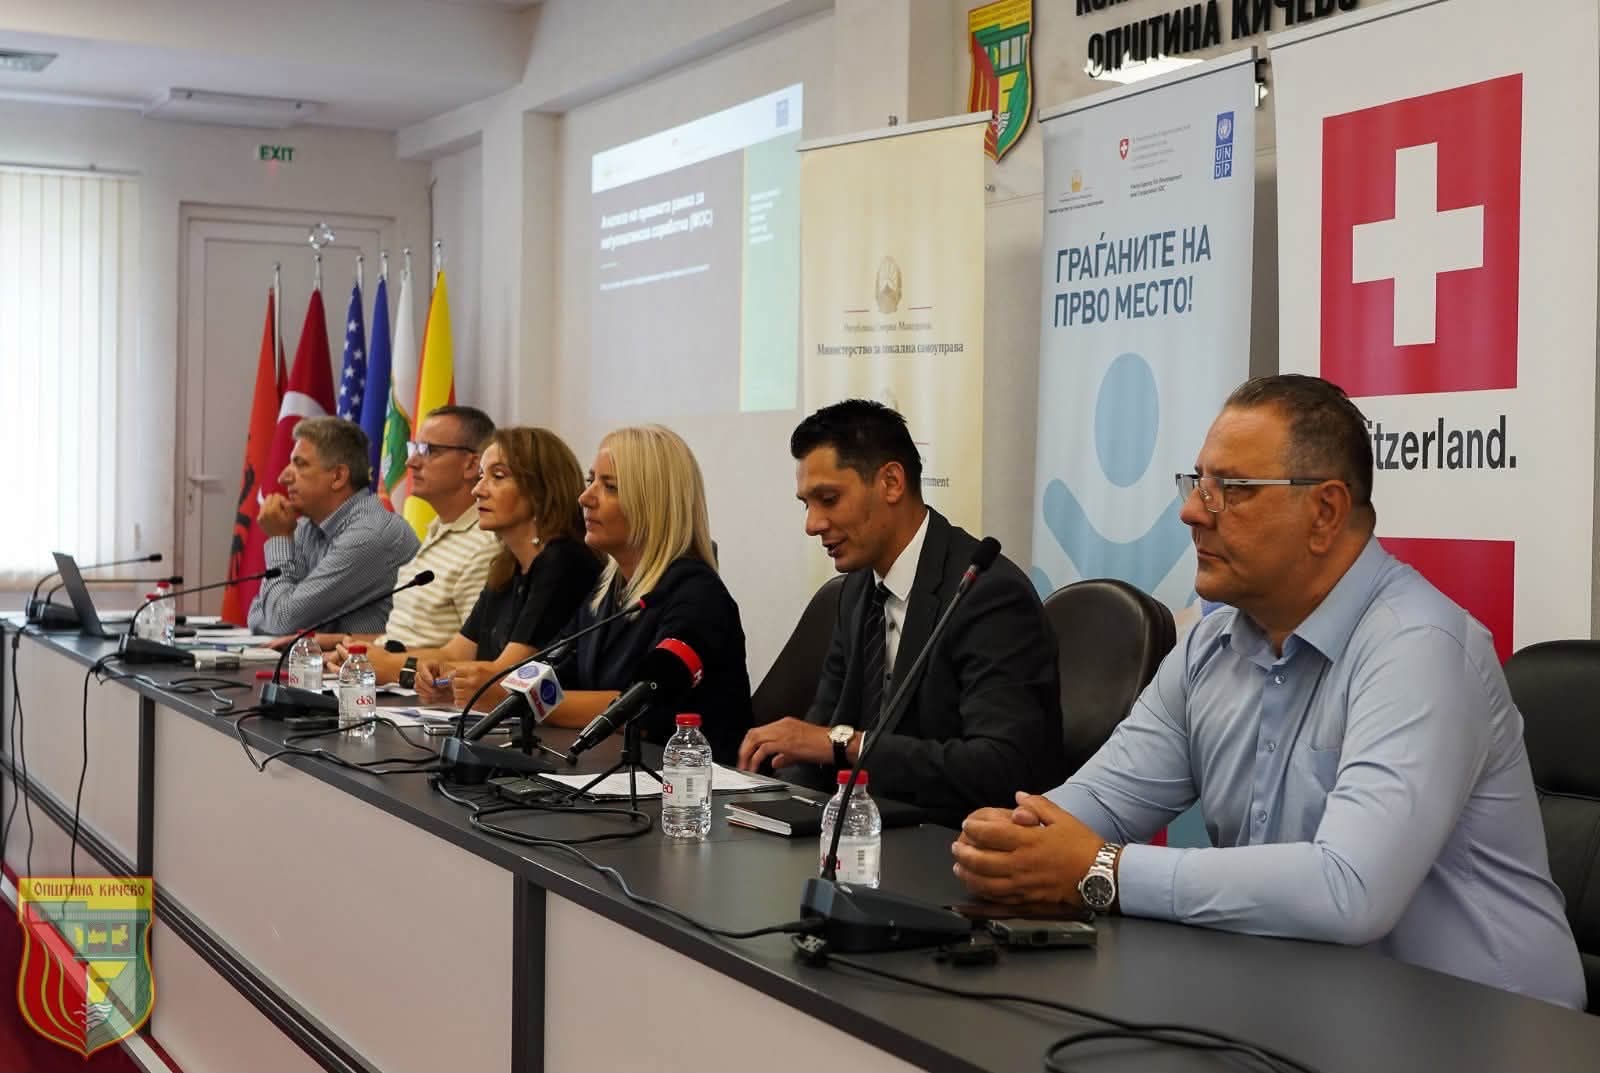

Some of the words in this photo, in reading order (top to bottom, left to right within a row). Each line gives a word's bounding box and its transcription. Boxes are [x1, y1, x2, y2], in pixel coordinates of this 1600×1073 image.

[1088, 0, 1220, 78] ОПШТИНА
[1231, 0, 1359, 40] КИЧЕ
[260, 145, 294, 161] EXIT
[1056, 231, 1176, 283] ГРАЃАНИТЕ
[1182, 224, 1211, 265] НА
[1054, 287, 1110, 328] ПРВО
[1115, 275, 1193, 321] МЕСТО!
[1368, 414, 1517, 470] tzerland.
